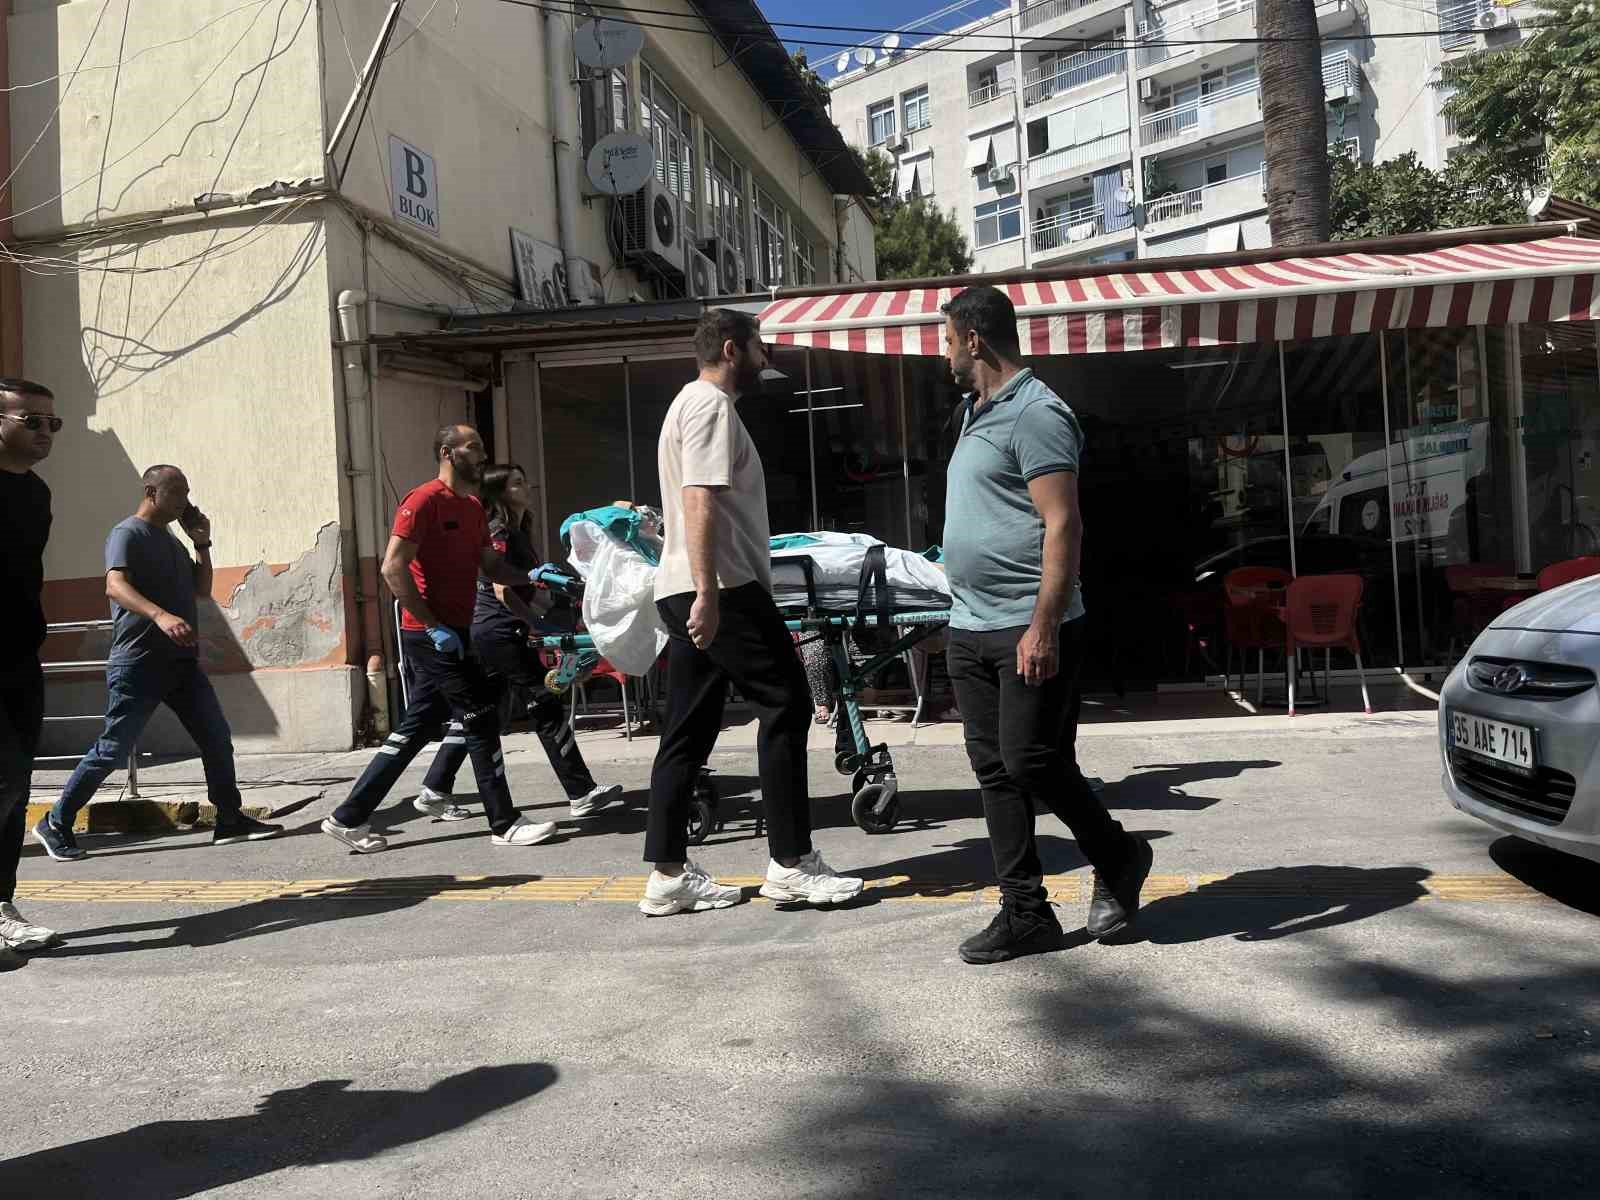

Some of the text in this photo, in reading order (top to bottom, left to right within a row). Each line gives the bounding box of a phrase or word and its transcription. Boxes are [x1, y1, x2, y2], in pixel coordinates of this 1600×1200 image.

[404, 147, 427, 198] B
[400, 195, 435, 228] BLOK
[1455, 716, 1528, 762] 35 AAE 714
